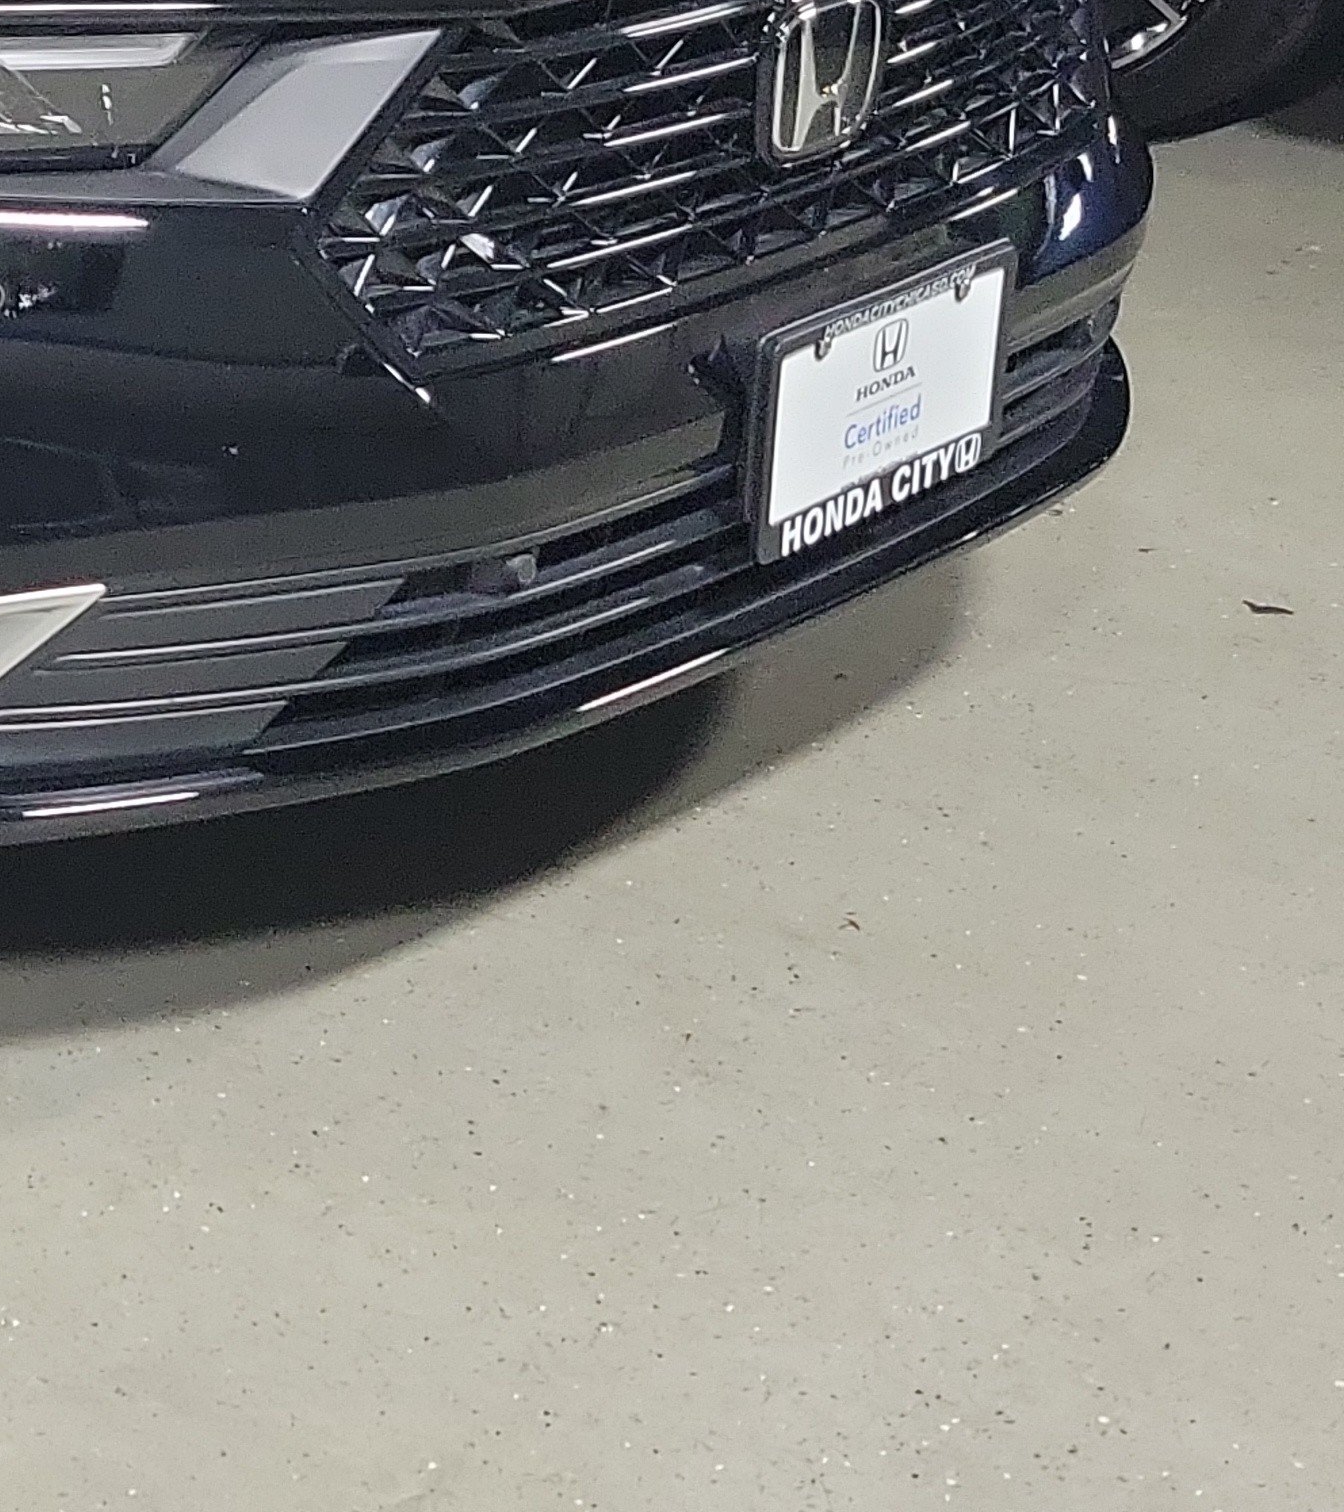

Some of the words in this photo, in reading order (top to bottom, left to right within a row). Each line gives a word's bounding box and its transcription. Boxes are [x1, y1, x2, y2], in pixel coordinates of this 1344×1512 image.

[855, 365, 917, 402] HONDA
[844, 392, 923, 449] Certified
[780, 478, 884, 557] HONDA
[891, 446, 959, 502] CITY
